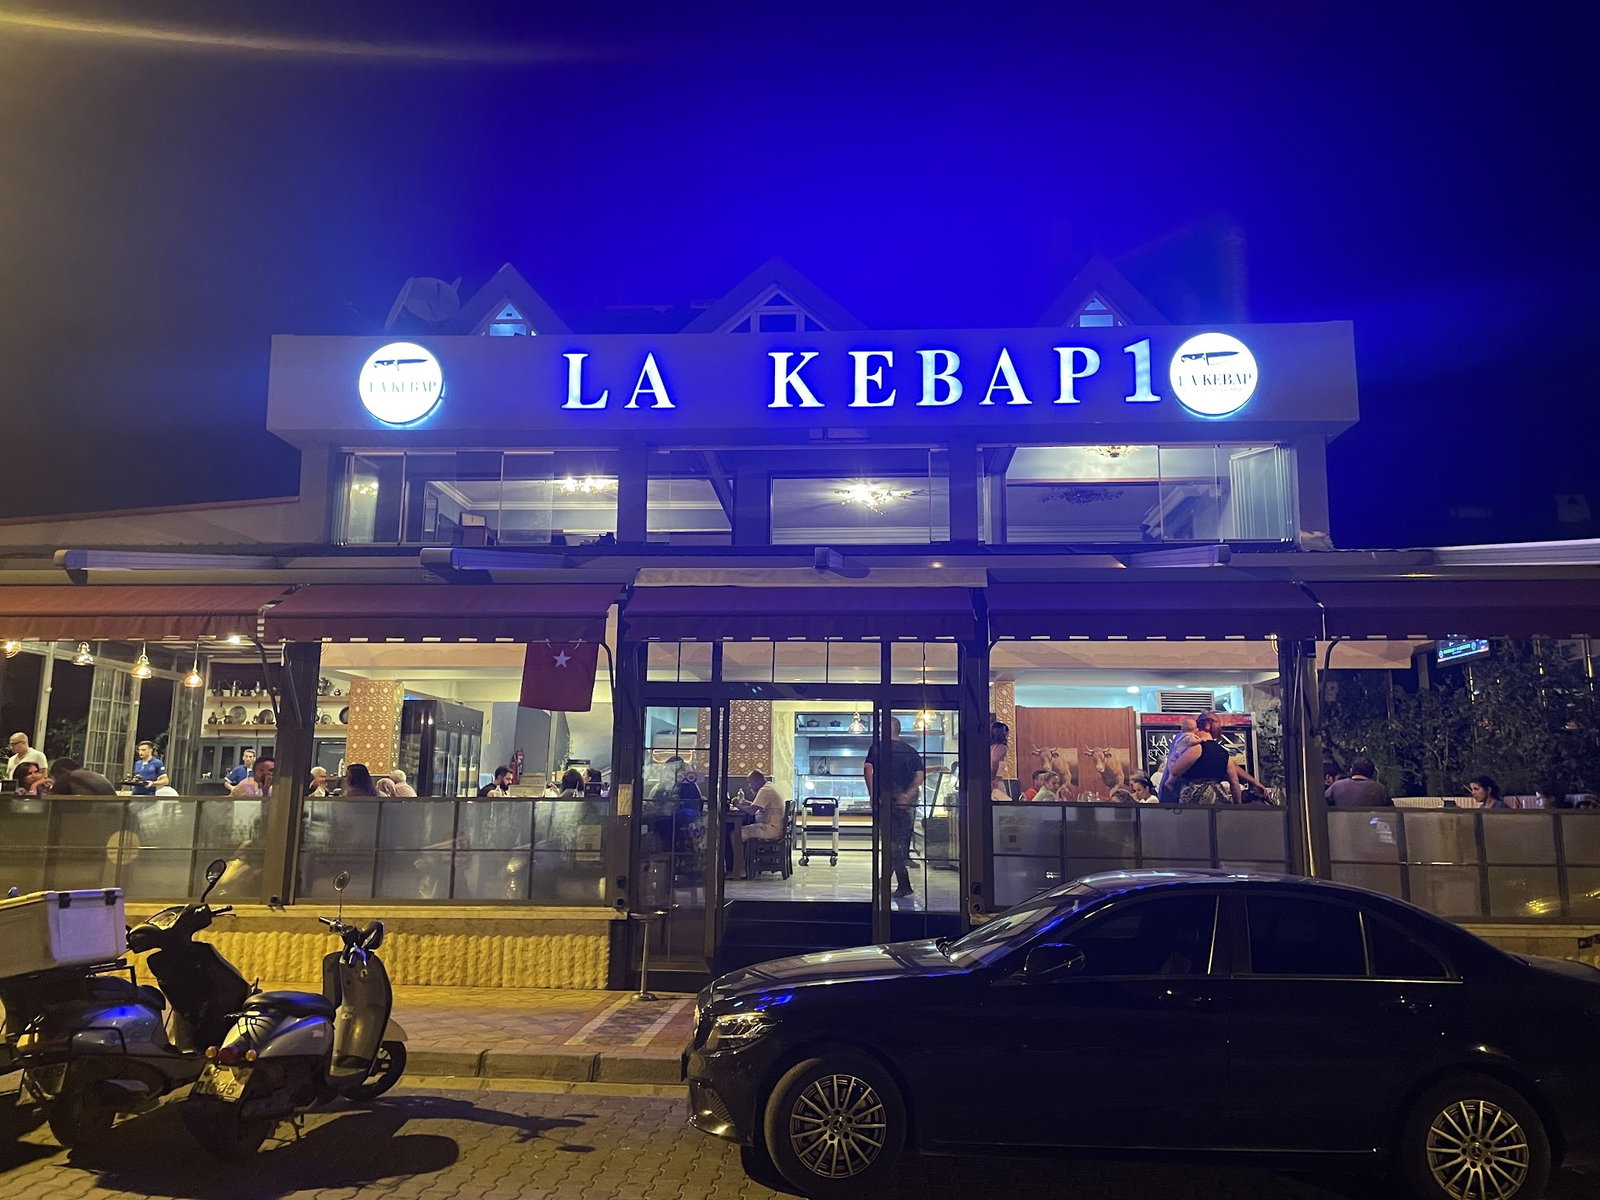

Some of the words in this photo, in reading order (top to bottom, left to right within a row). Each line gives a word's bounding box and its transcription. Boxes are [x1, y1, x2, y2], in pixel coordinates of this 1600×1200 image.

[561, 351, 677, 410] LA
[1202, 372, 1252, 387] KEBAP
[1152, 735, 1168, 747] LA
